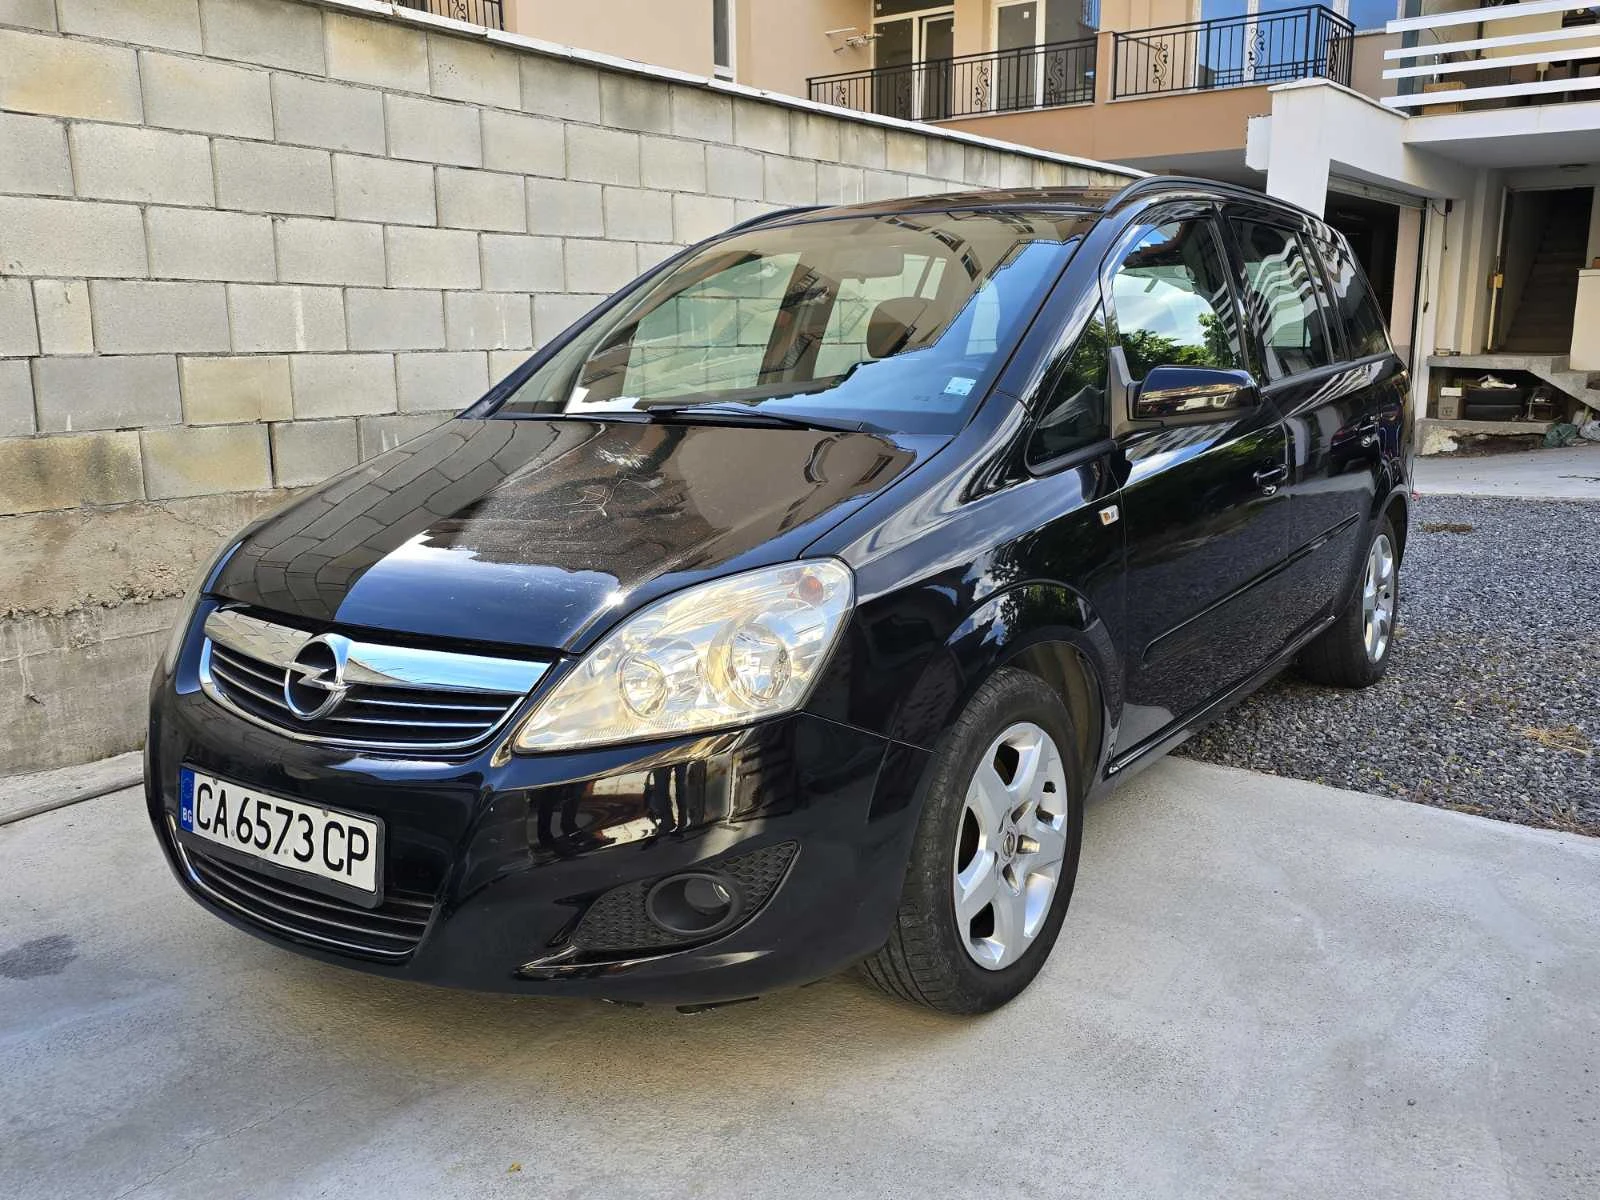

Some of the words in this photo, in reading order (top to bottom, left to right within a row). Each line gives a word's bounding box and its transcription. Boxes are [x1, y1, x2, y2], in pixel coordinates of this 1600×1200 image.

[182, 807, 193, 823] BG
[196, 782, 229, 838] CA
[235, 797, 314, 862] 6573
[322, 820, 370, 876] CP
